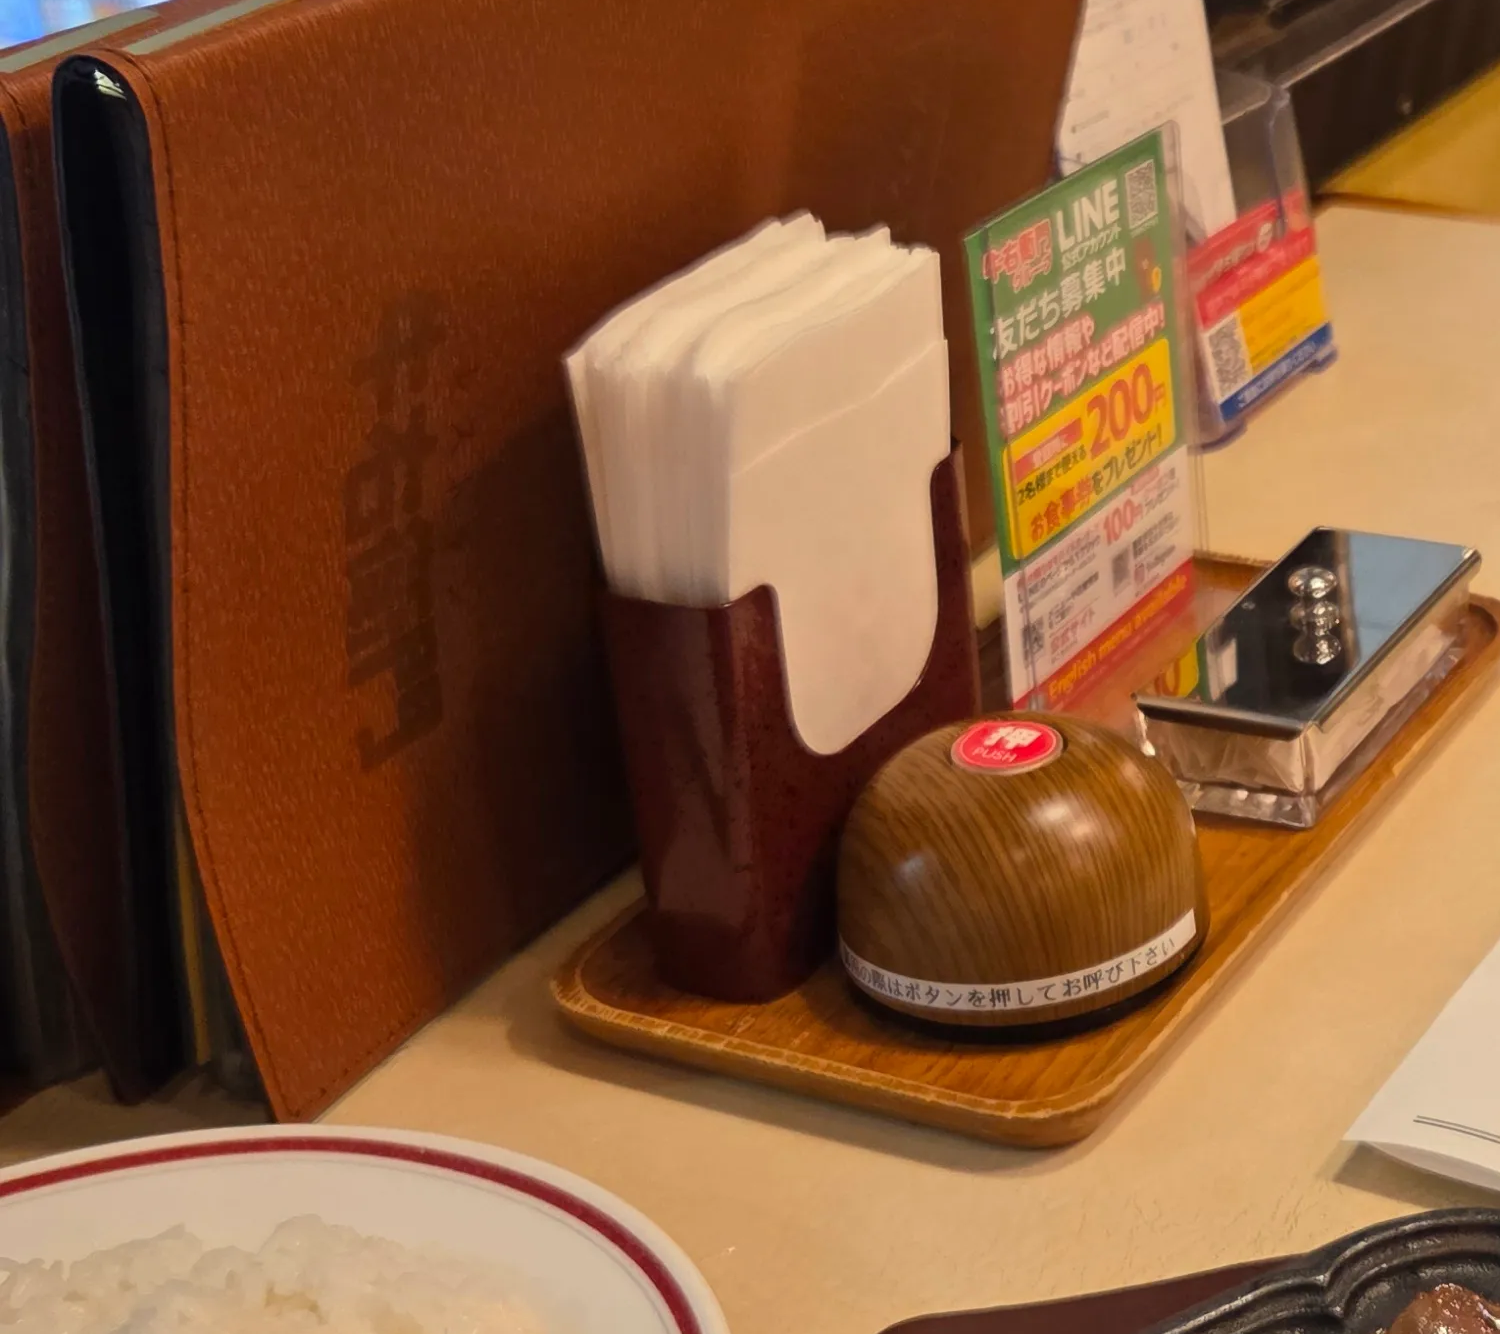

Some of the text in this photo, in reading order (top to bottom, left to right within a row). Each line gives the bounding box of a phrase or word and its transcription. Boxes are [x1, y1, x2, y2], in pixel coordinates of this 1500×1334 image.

[1057, 180, 1119, 252] LINE
[990, 247, 1126, 360] 友だち募集中
[972, 746, 1018, 763] PUSH
